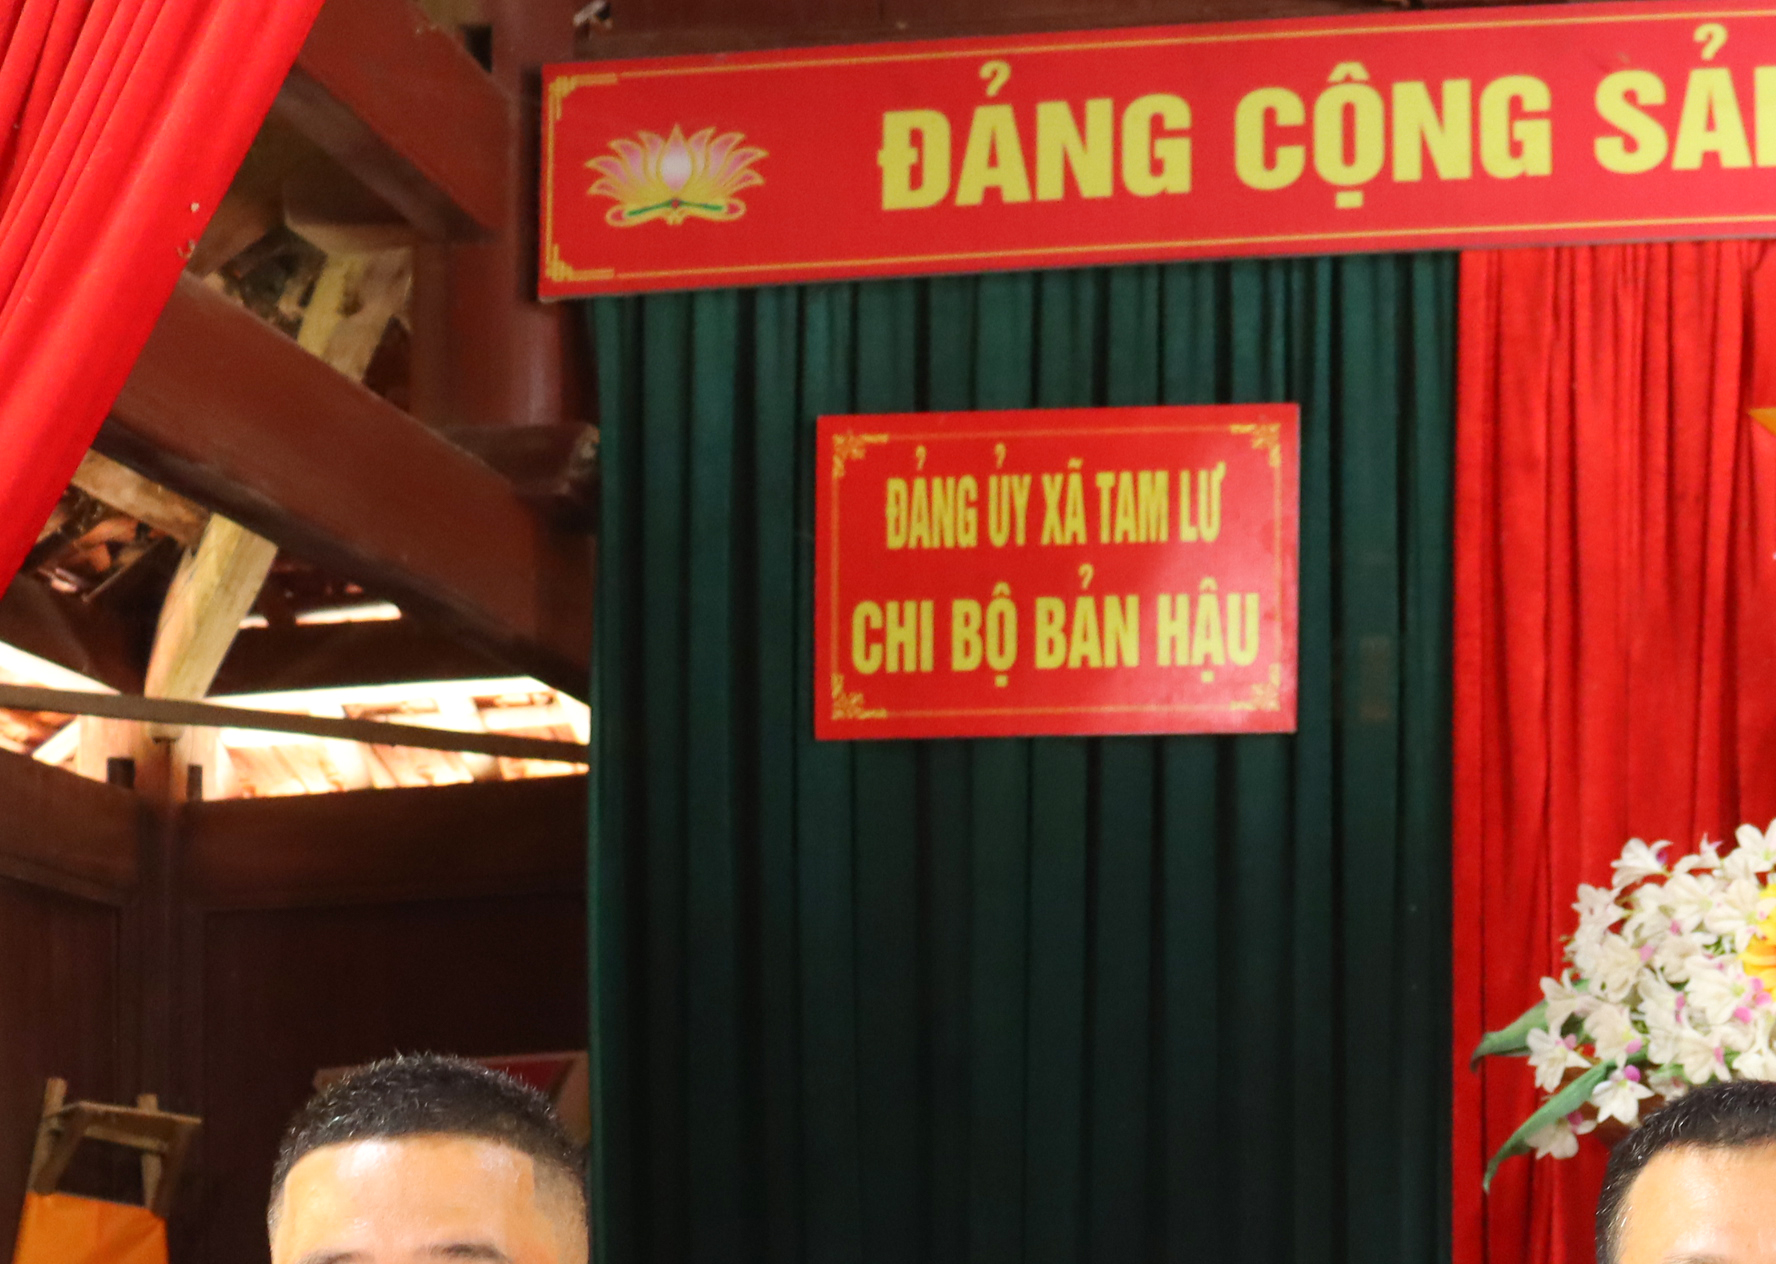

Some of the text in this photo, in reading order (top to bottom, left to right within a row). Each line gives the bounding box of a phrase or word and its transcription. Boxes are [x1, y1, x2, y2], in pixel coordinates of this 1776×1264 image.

[877, 60, 1192, 211] ĐẢNG
[1234, 61, 1553, 209] CỘNG
[885, 443, 1226, 549] ĐẢNG ỦY XÃ TAM LƯ
[851, 563, 1260, 687] CHI BỘ BẢN HẬU
